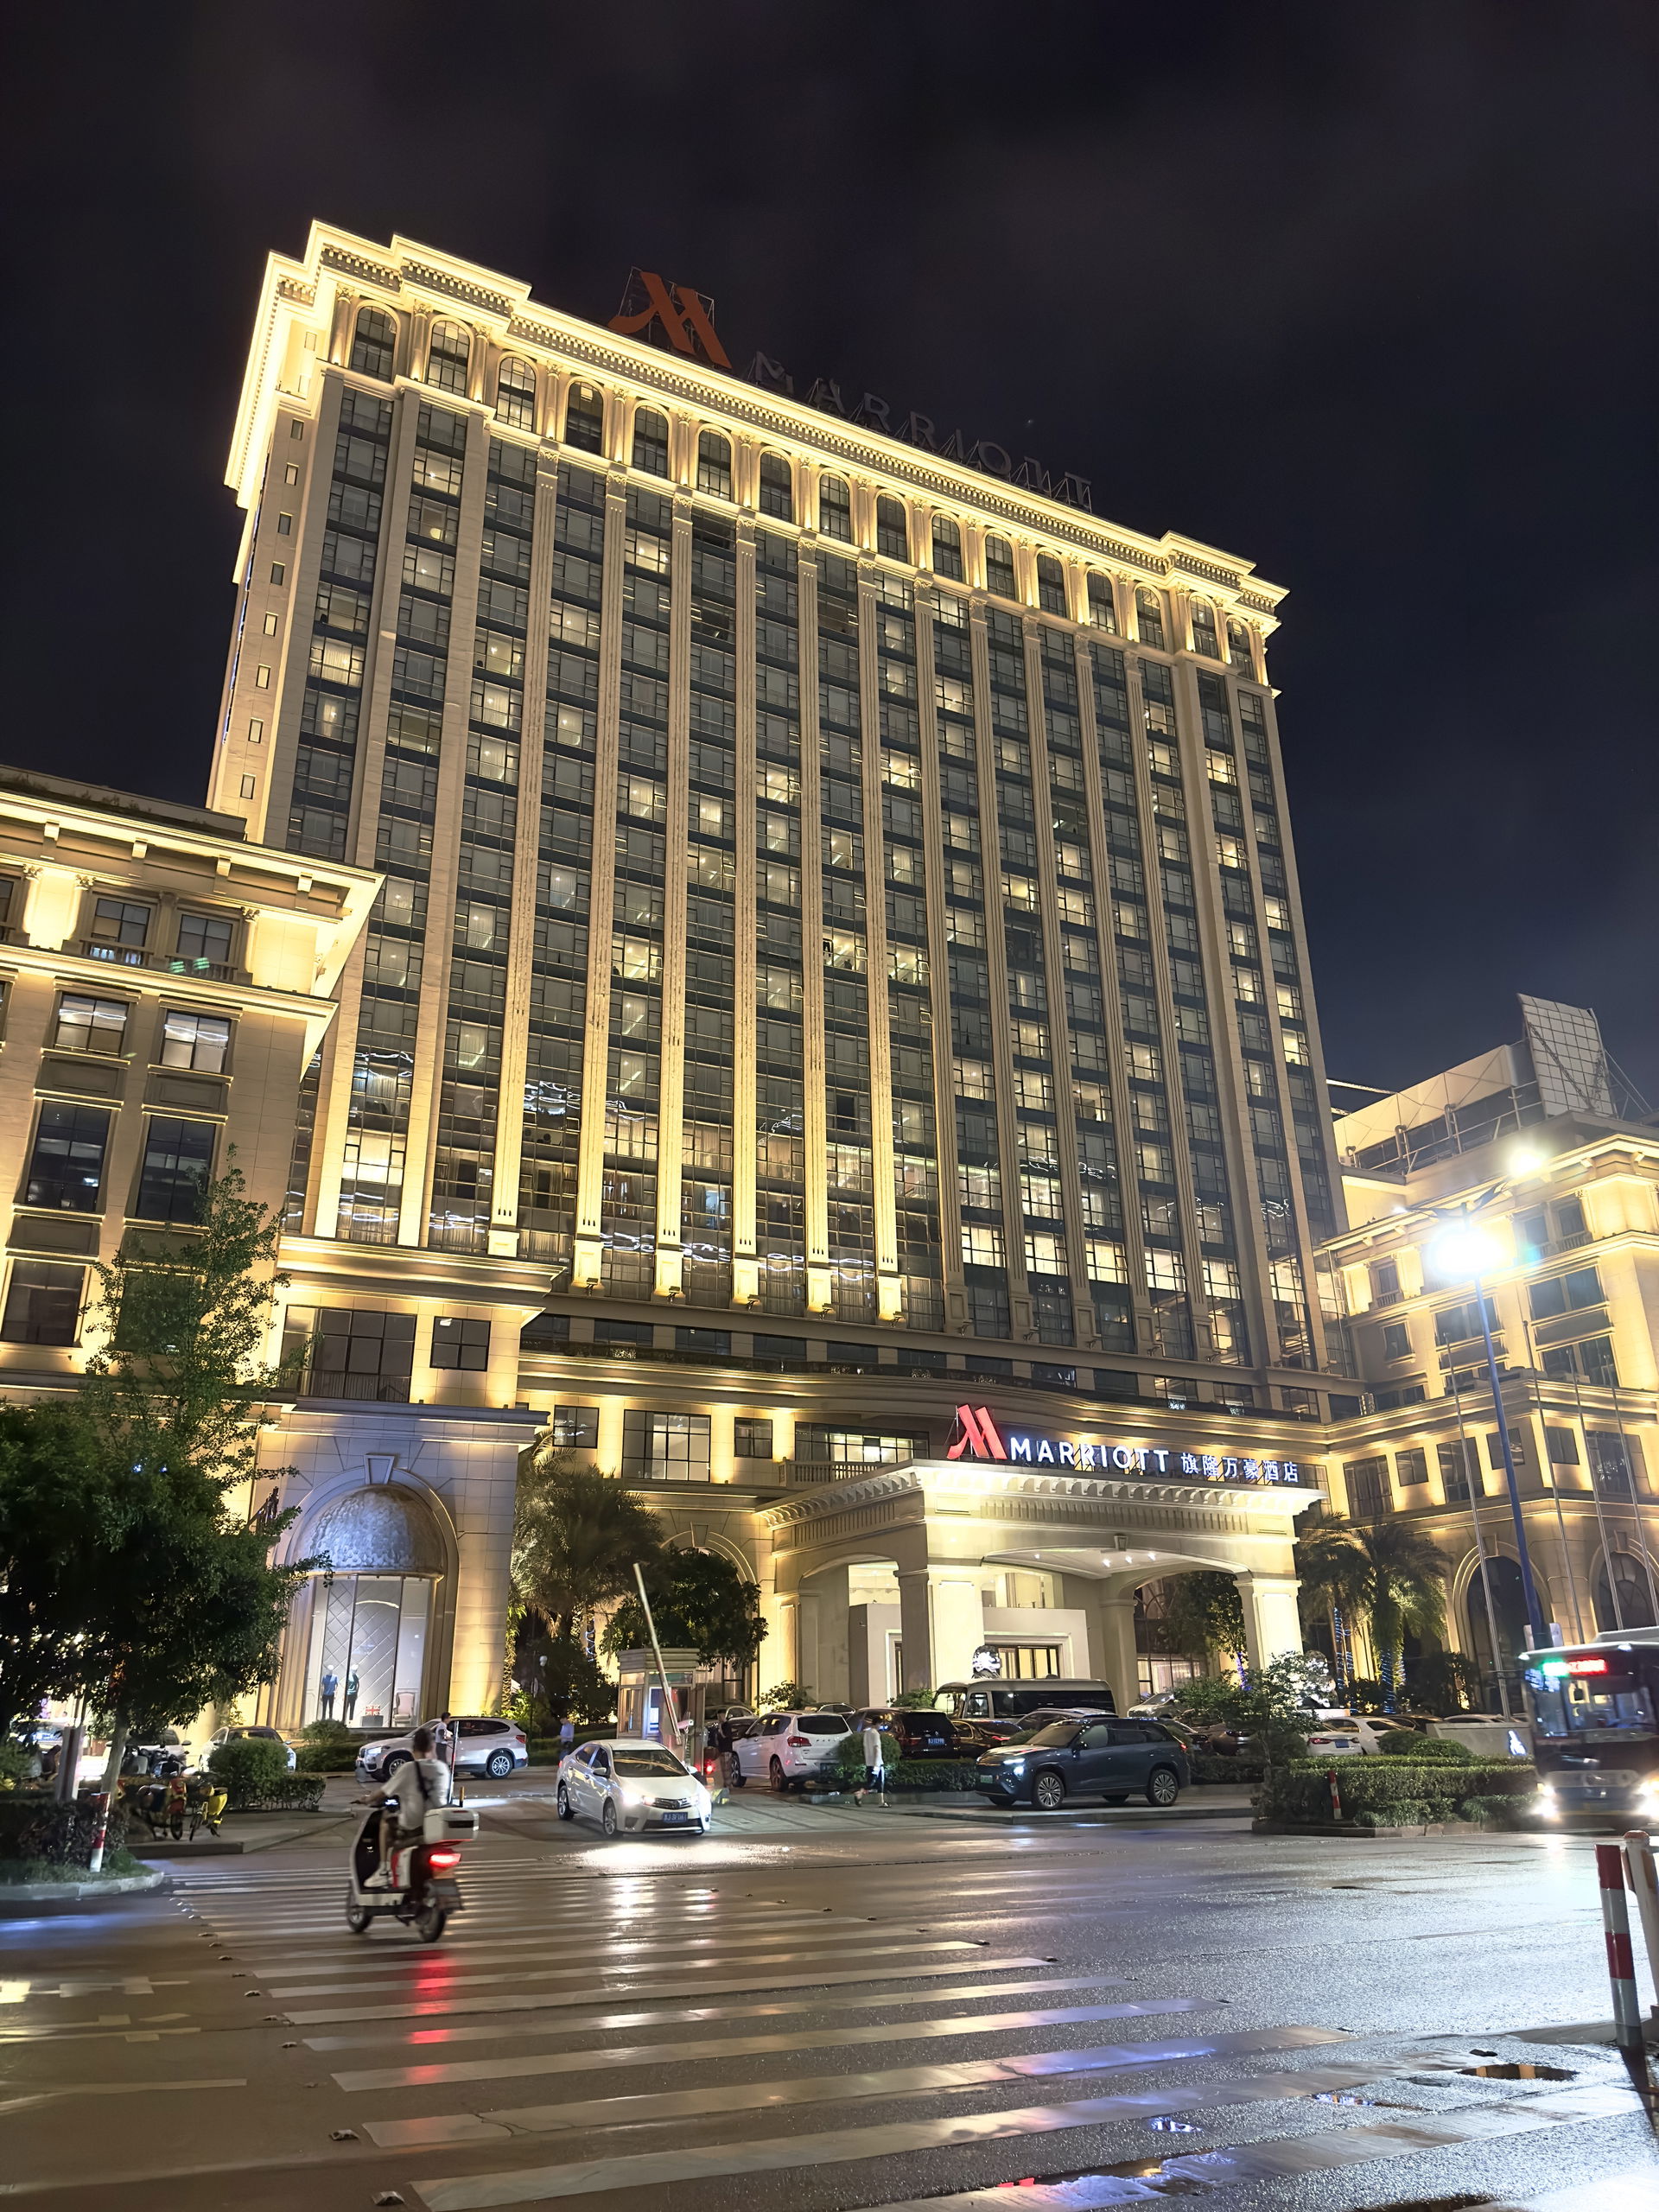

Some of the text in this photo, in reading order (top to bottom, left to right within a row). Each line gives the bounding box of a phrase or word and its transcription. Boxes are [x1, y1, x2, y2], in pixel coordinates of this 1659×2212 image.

[755, 351, 1091, 506] MARRIOTT
[1010, 1437, 1169, 1472] MARRIOTT
[1180, 1452, 1299, 1483] 旗隆万豪酒店
